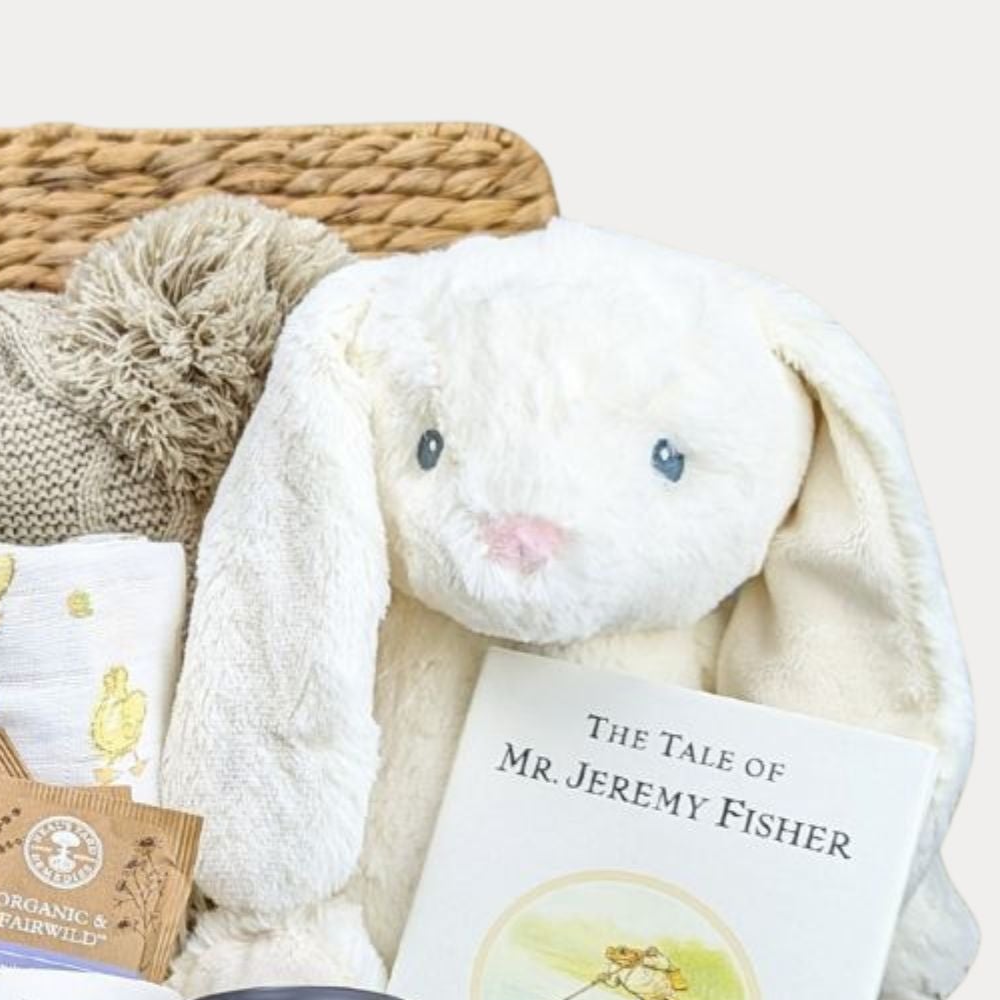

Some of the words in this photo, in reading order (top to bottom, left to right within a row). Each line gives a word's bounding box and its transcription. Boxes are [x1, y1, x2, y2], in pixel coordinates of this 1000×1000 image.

[587, 714, 649, 750] THE
[660, 731, 735, 771] TALE
[745, 757, 786, 783] OF
[495, 742, 558, 785] MR.
[565, 762, 709, 821] JEREMY
[715, 797, 852, 859] FISHER
[94, 913, 107, 929] &
